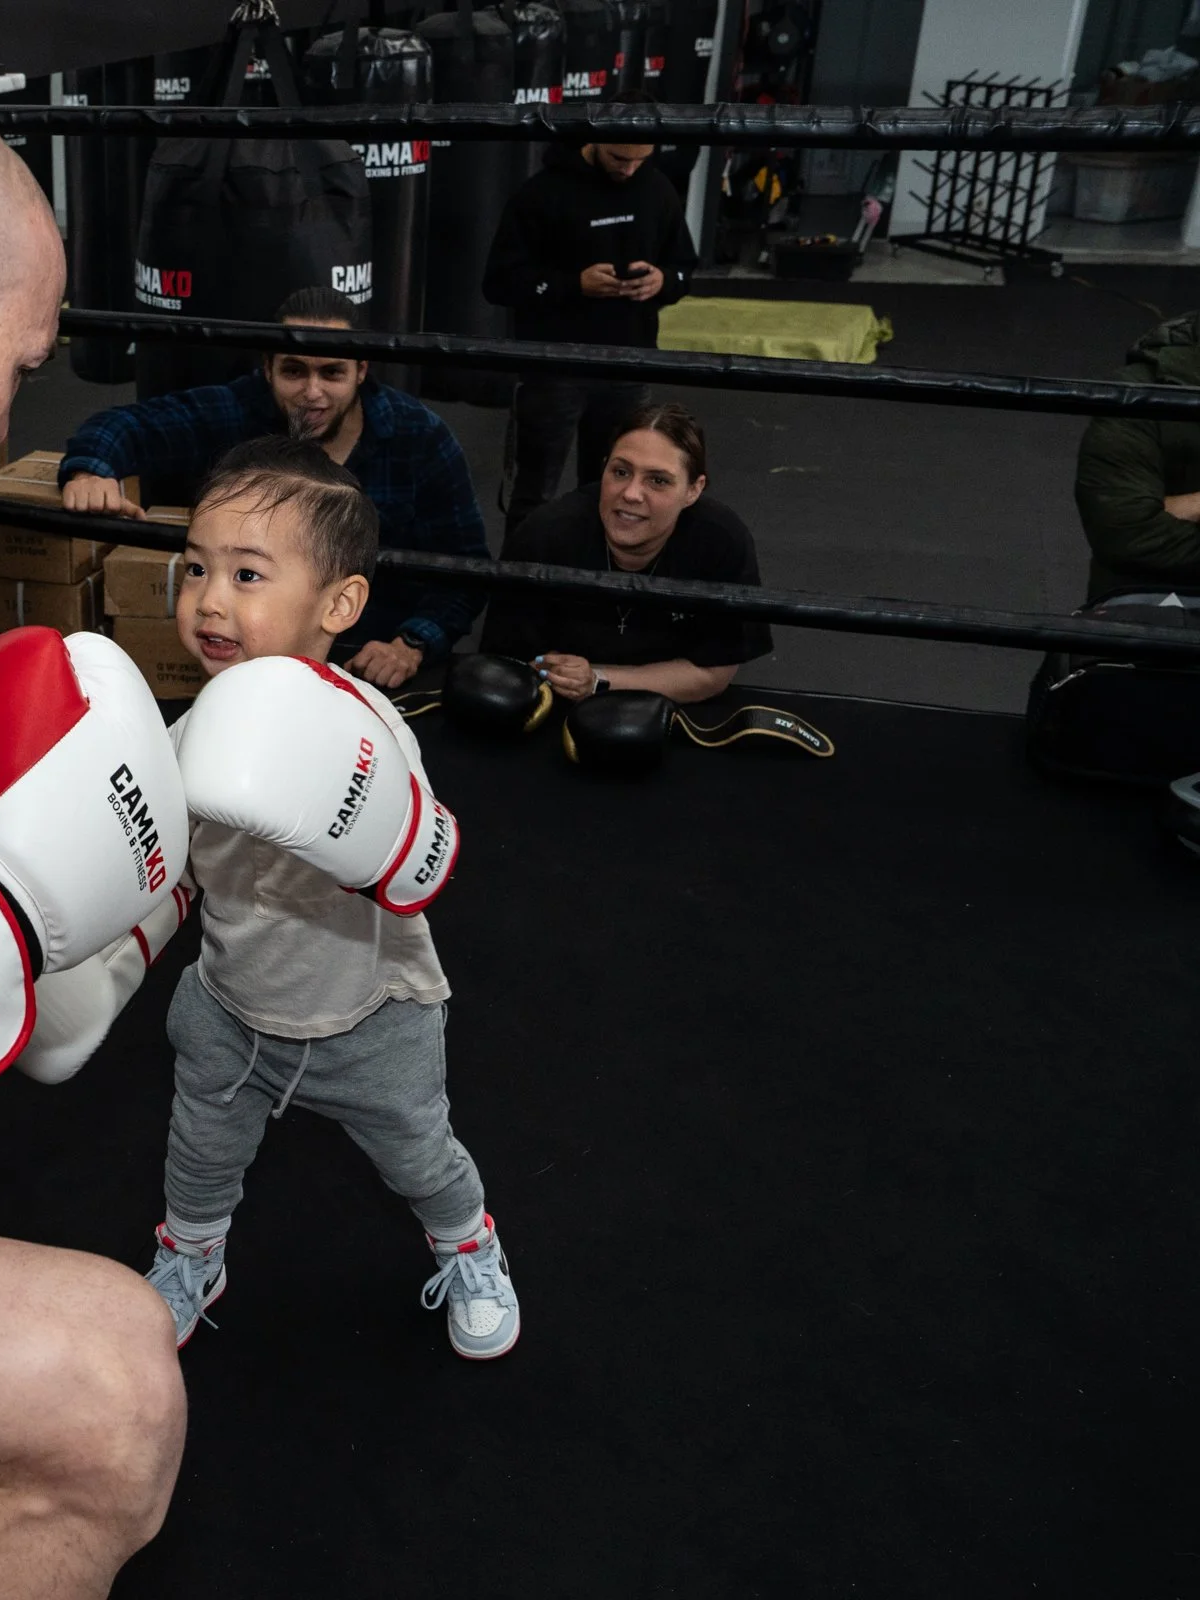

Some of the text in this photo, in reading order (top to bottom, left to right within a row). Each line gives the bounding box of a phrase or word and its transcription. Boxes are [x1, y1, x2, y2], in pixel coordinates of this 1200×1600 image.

[562, 69, 607, 89] MAKO
[365, 166, 392, 179] OXING
[109, 763, 167, 894] CAMAKO
[327, 736, 374, 840] CAMAKO
[344, 804, 364, 836] BOXING
[364, 756, 379, 794] FITNESS
[107, 792, 148, 891] BOXING & FITNESS
